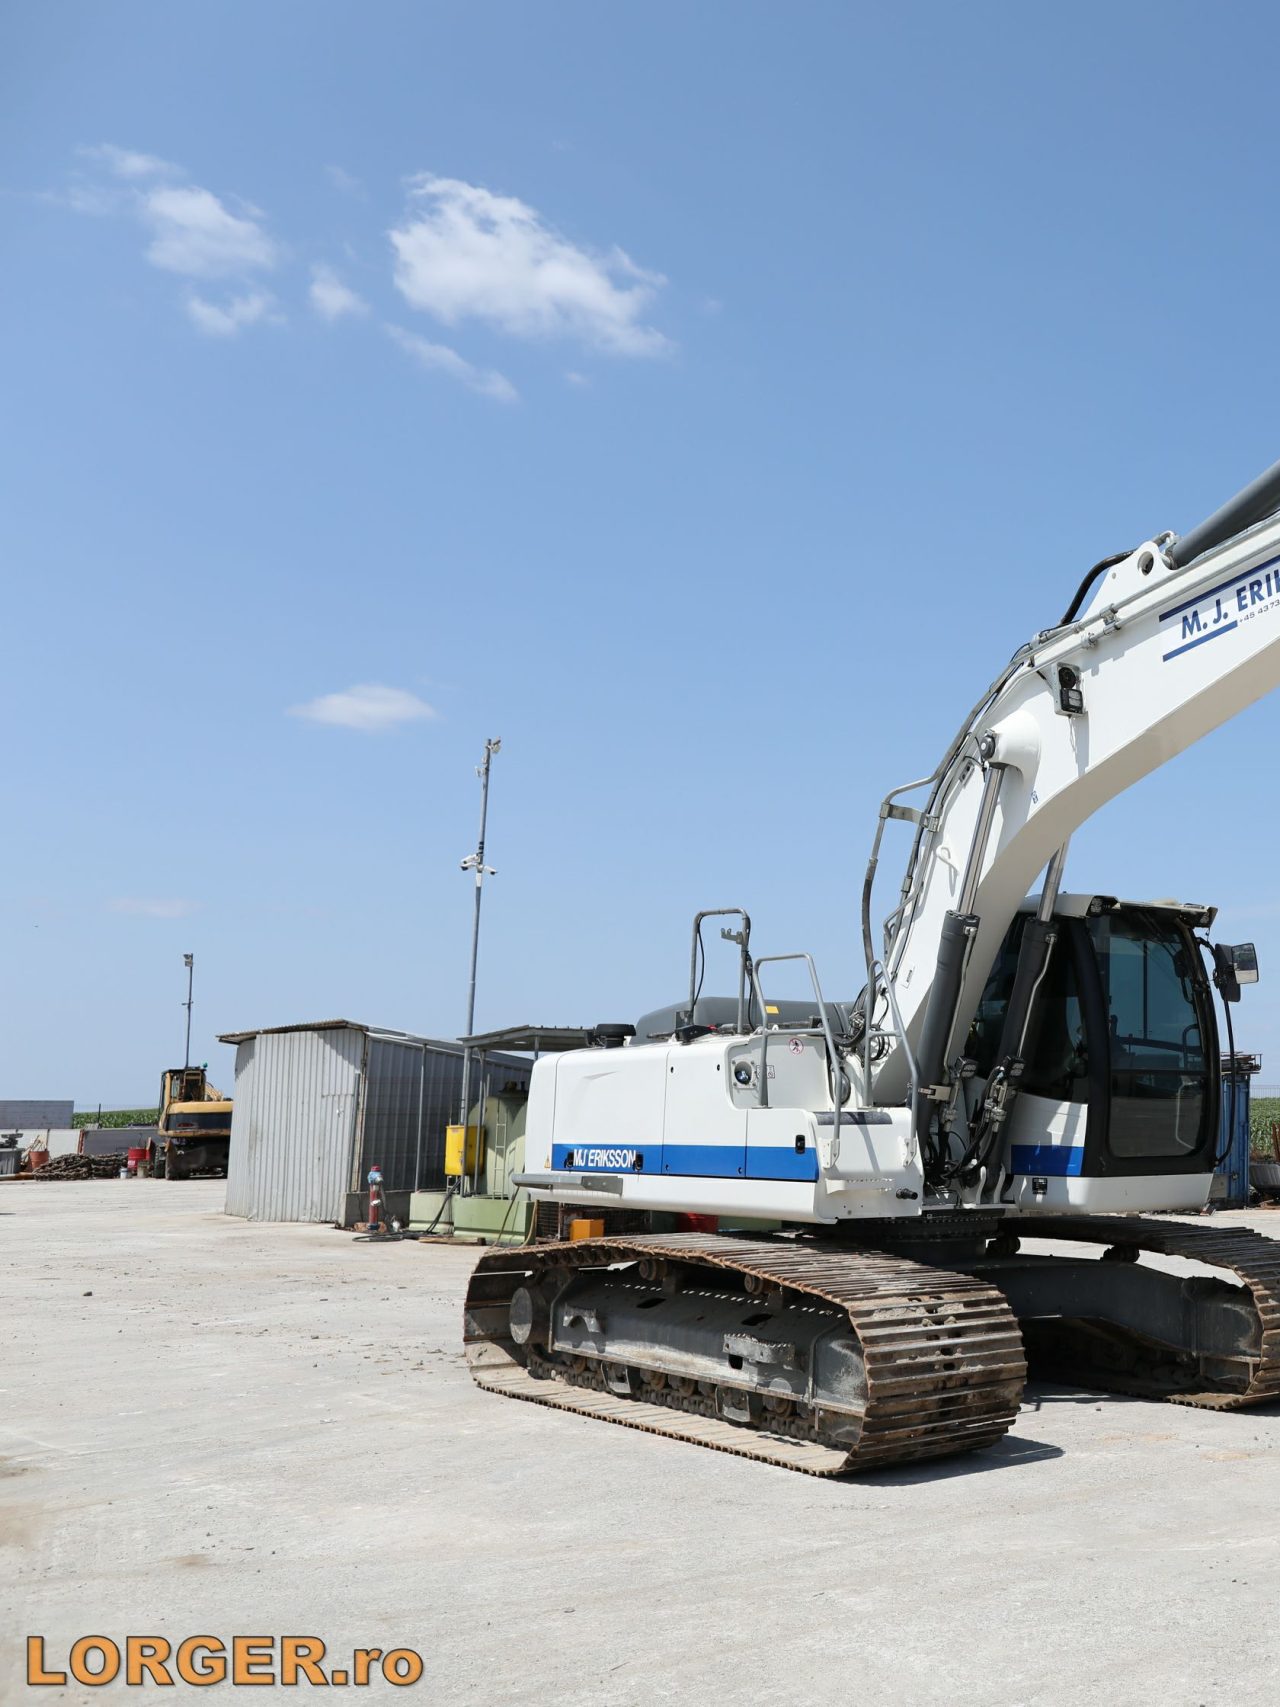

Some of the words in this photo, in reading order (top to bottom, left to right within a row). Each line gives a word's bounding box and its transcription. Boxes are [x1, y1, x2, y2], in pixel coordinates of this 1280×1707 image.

[1181, 610, 1208, 640] M.
[1212, 598, 1229, 625] J.
[1239, 611, 1256, 623] +45
[573, 1148, 587, 1167] MJ
[587, 1149, 637, 1168] ERIKSSON
